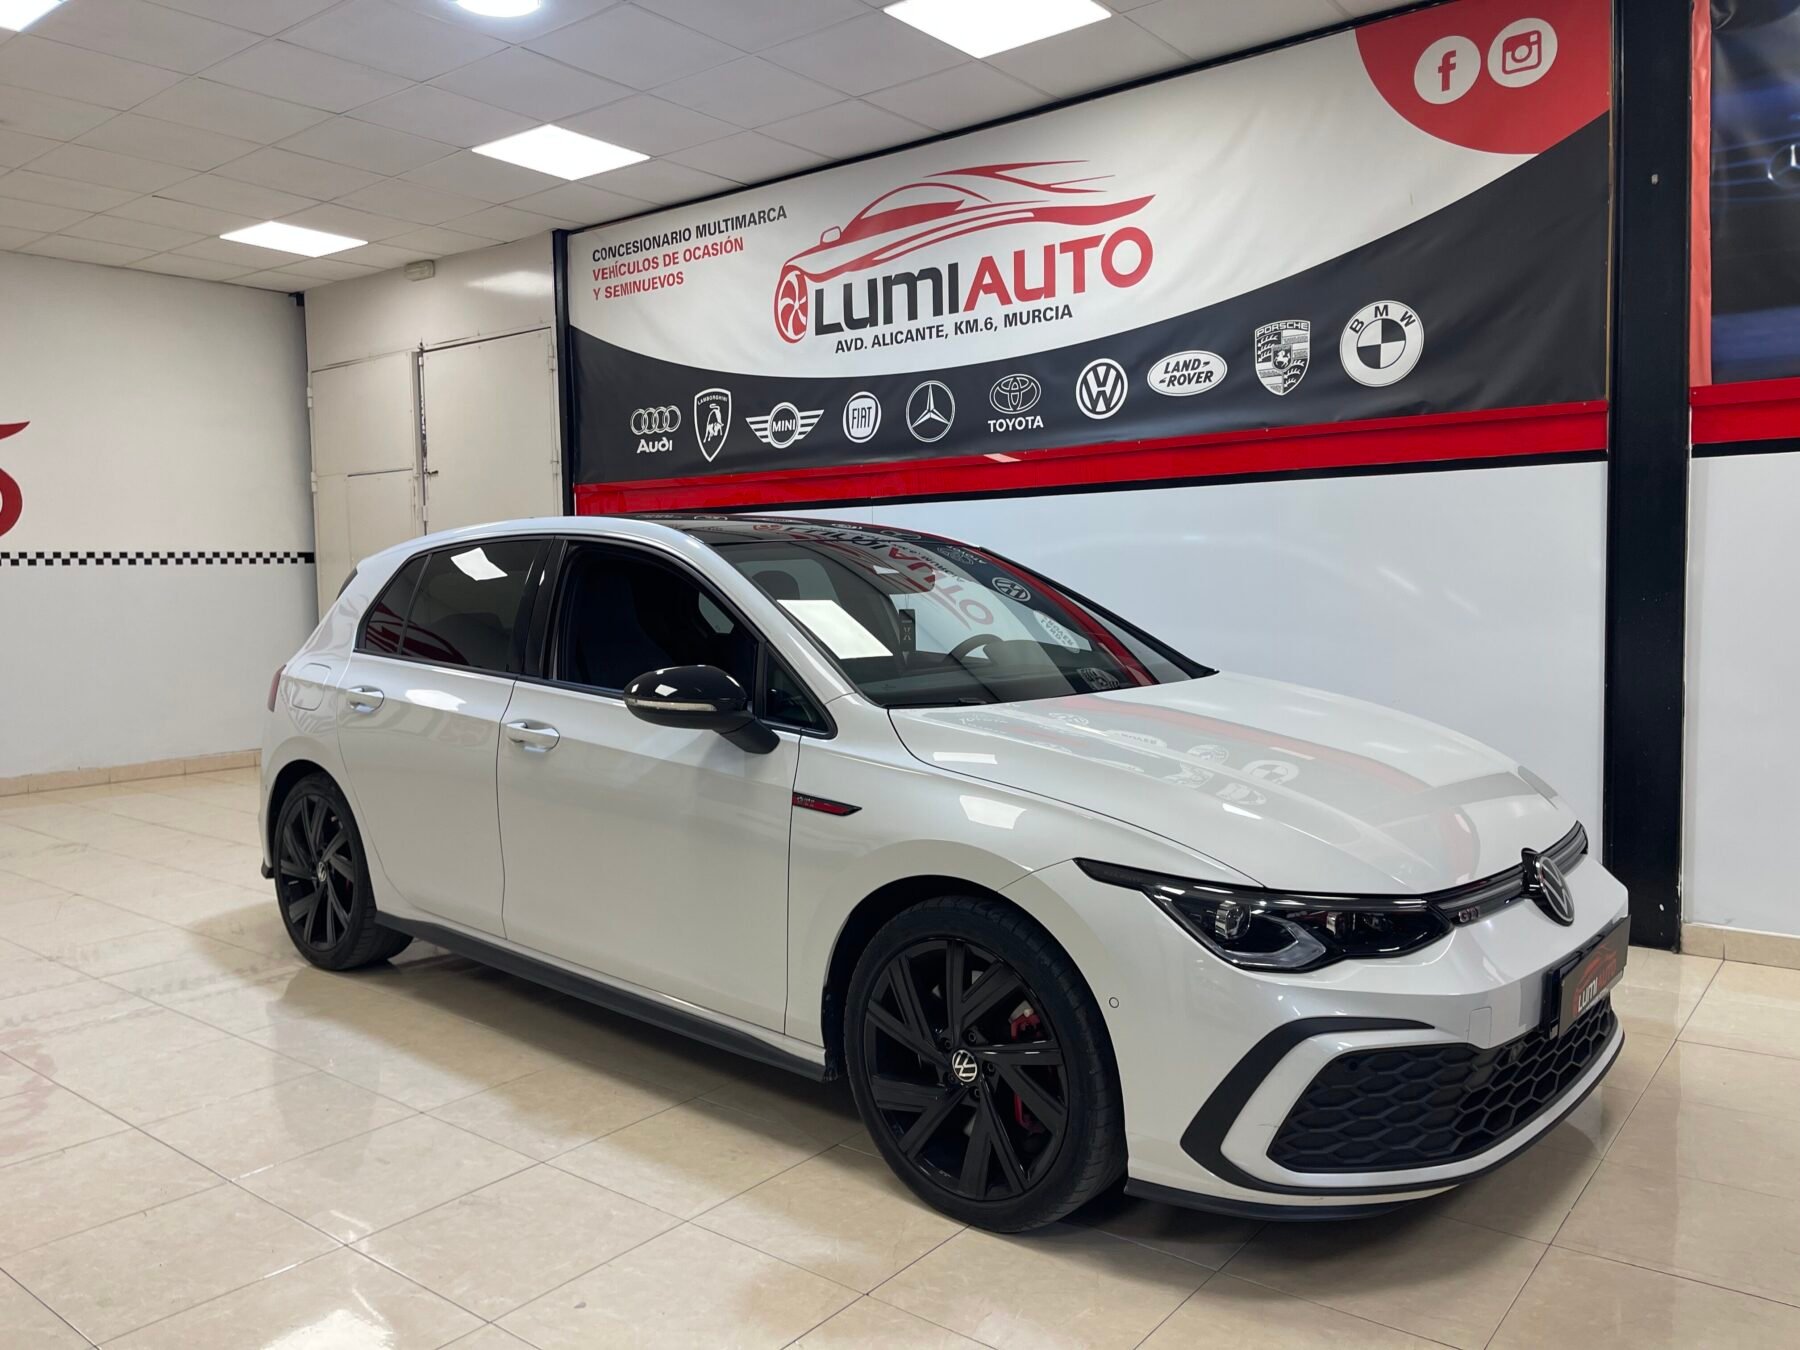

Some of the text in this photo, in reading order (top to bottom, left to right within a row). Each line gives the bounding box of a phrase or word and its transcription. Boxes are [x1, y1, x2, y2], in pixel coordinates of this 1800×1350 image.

[592, 205, 788, 262] CONCESIONARIO MULTIMARCA
[592, 236, 745, 281] VEHÍCULOS DE OCASIÓN
[593, 271, 684, 300] Y SEMINUEVOS
[835, 304, 1073, 354] AVD. ALICANTE, KM.6, MURCIA
[1256, 320, 1311, 336] PORSCHE
[1349, 304, 1416, 335] BMW
[772, 419, 796, 432] MINI
[852, 406, 873, 430] FIAT
[987, 415, 1044, 432] TOYOTA
[636, 437, 673, 454] Audi
